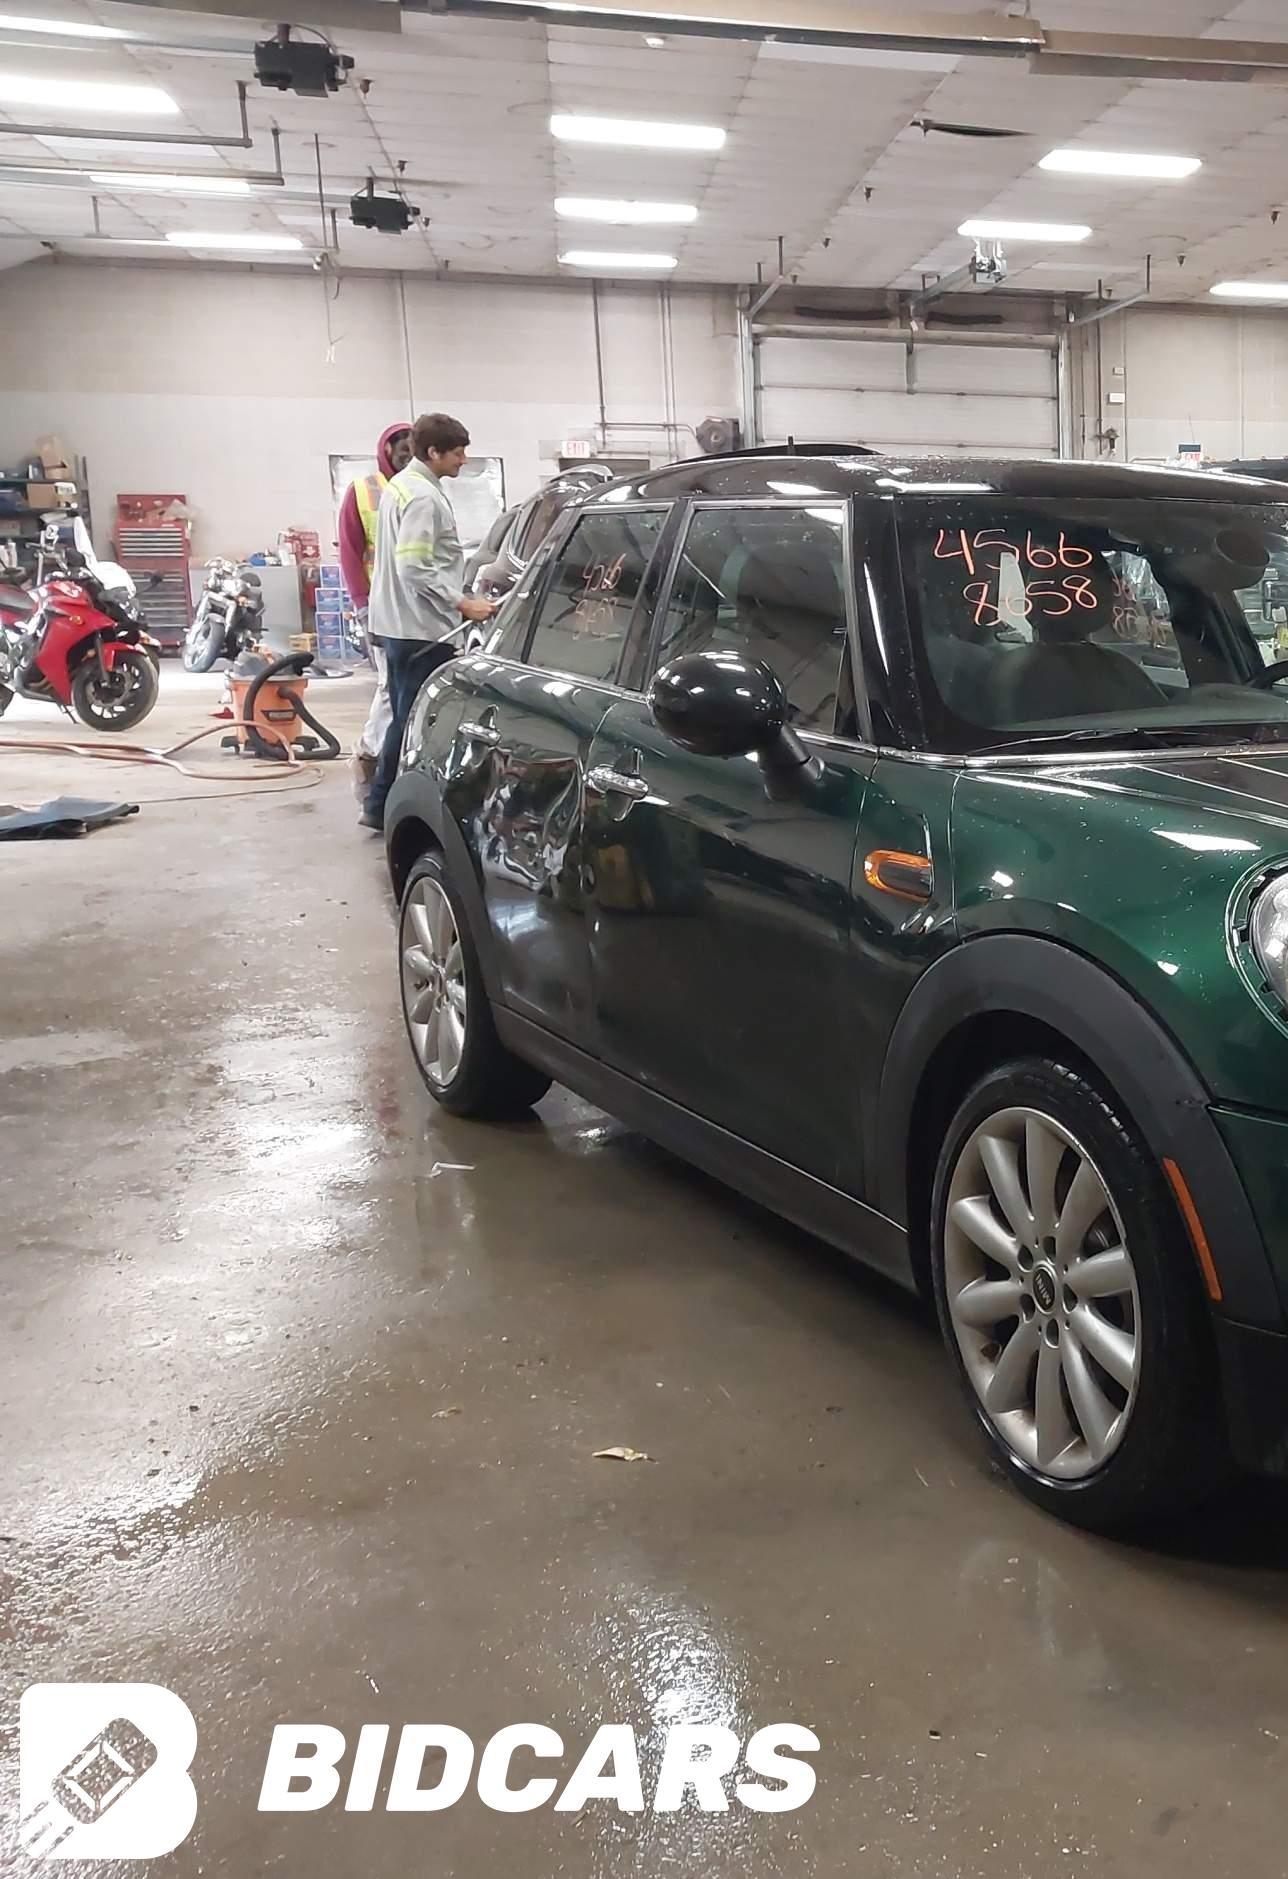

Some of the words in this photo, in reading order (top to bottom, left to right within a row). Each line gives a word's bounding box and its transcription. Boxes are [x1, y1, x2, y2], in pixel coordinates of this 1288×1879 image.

[934, 528, 1093, 575] 4566
[962, 574, 1098, 627] 8658
[1034, 1272, 1052, 1306] MINI
